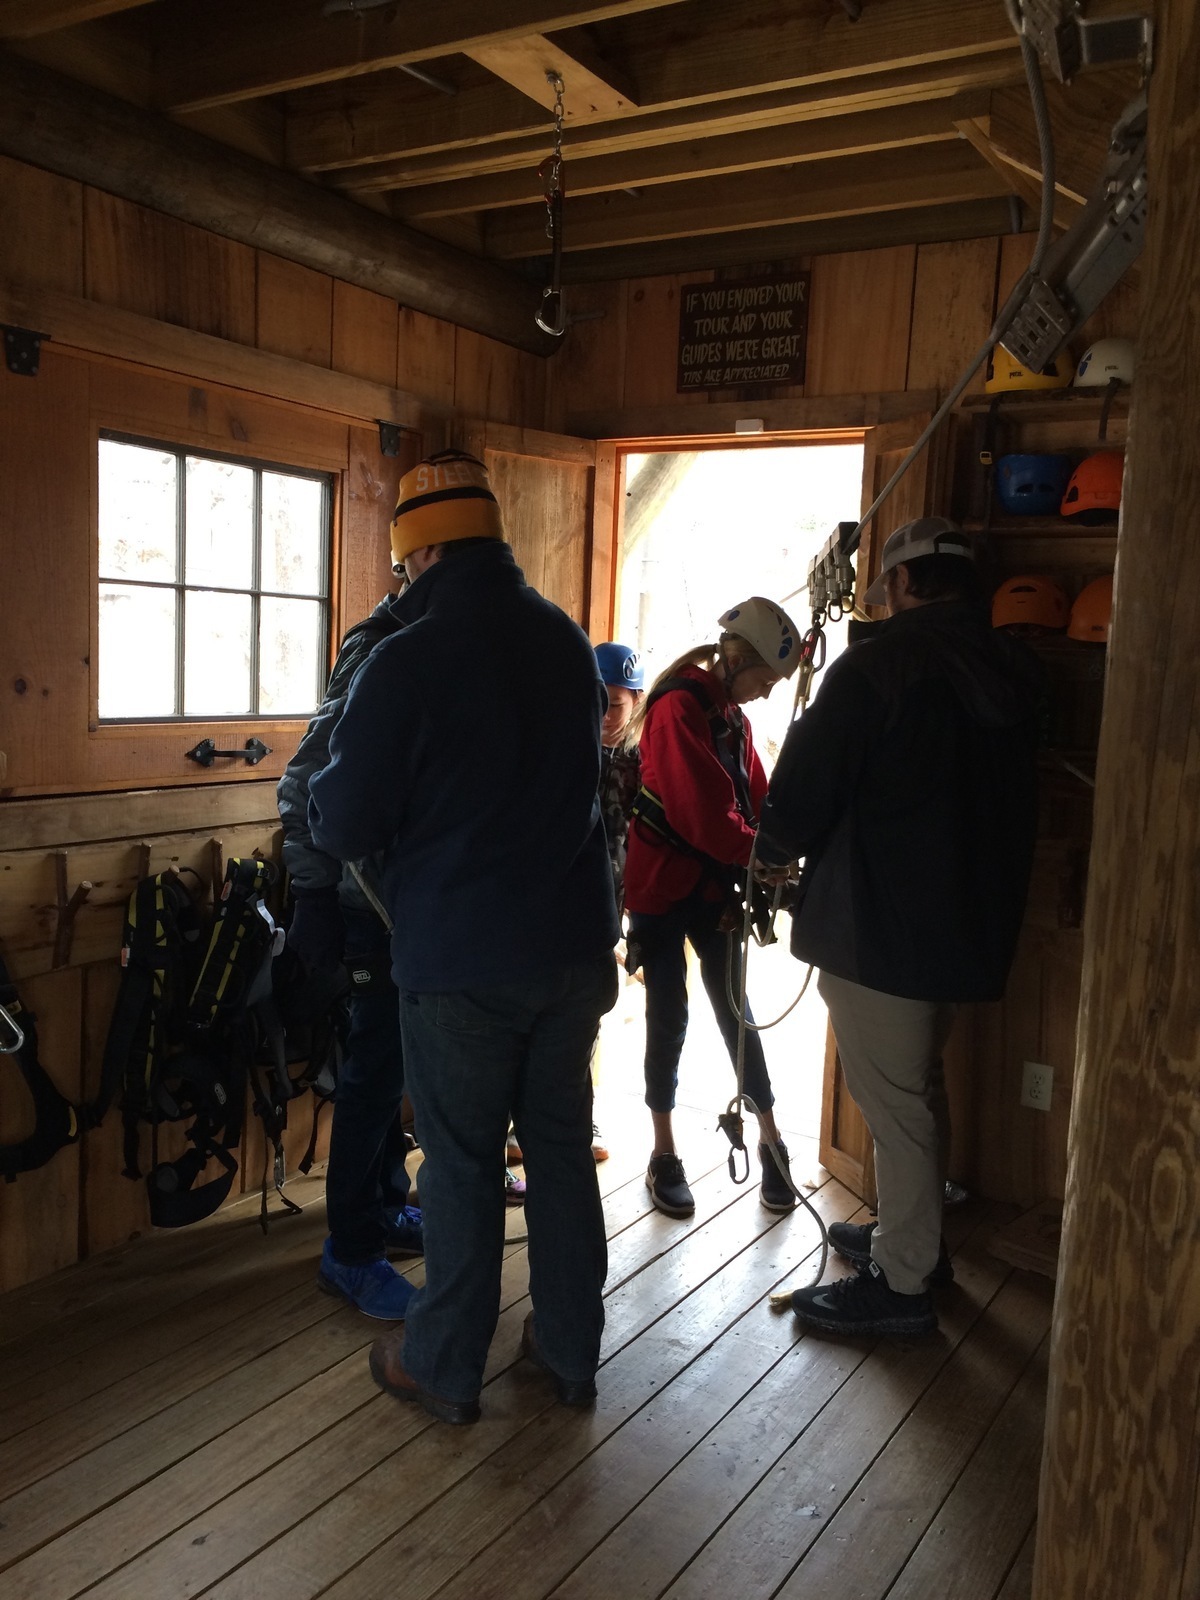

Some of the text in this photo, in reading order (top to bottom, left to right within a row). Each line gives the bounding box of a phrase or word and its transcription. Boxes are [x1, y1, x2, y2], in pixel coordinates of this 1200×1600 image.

[686, 281, 806, 313] IF YOU ENJOYED YOUR
[694, 309, 793, 337] TOUR AND YOUR
[681, 342, 722, 366] GUIDES
[725, 339, 760, 362] WERE
[683, 363, 790, 384] TIPS ARE APPRECIATED
